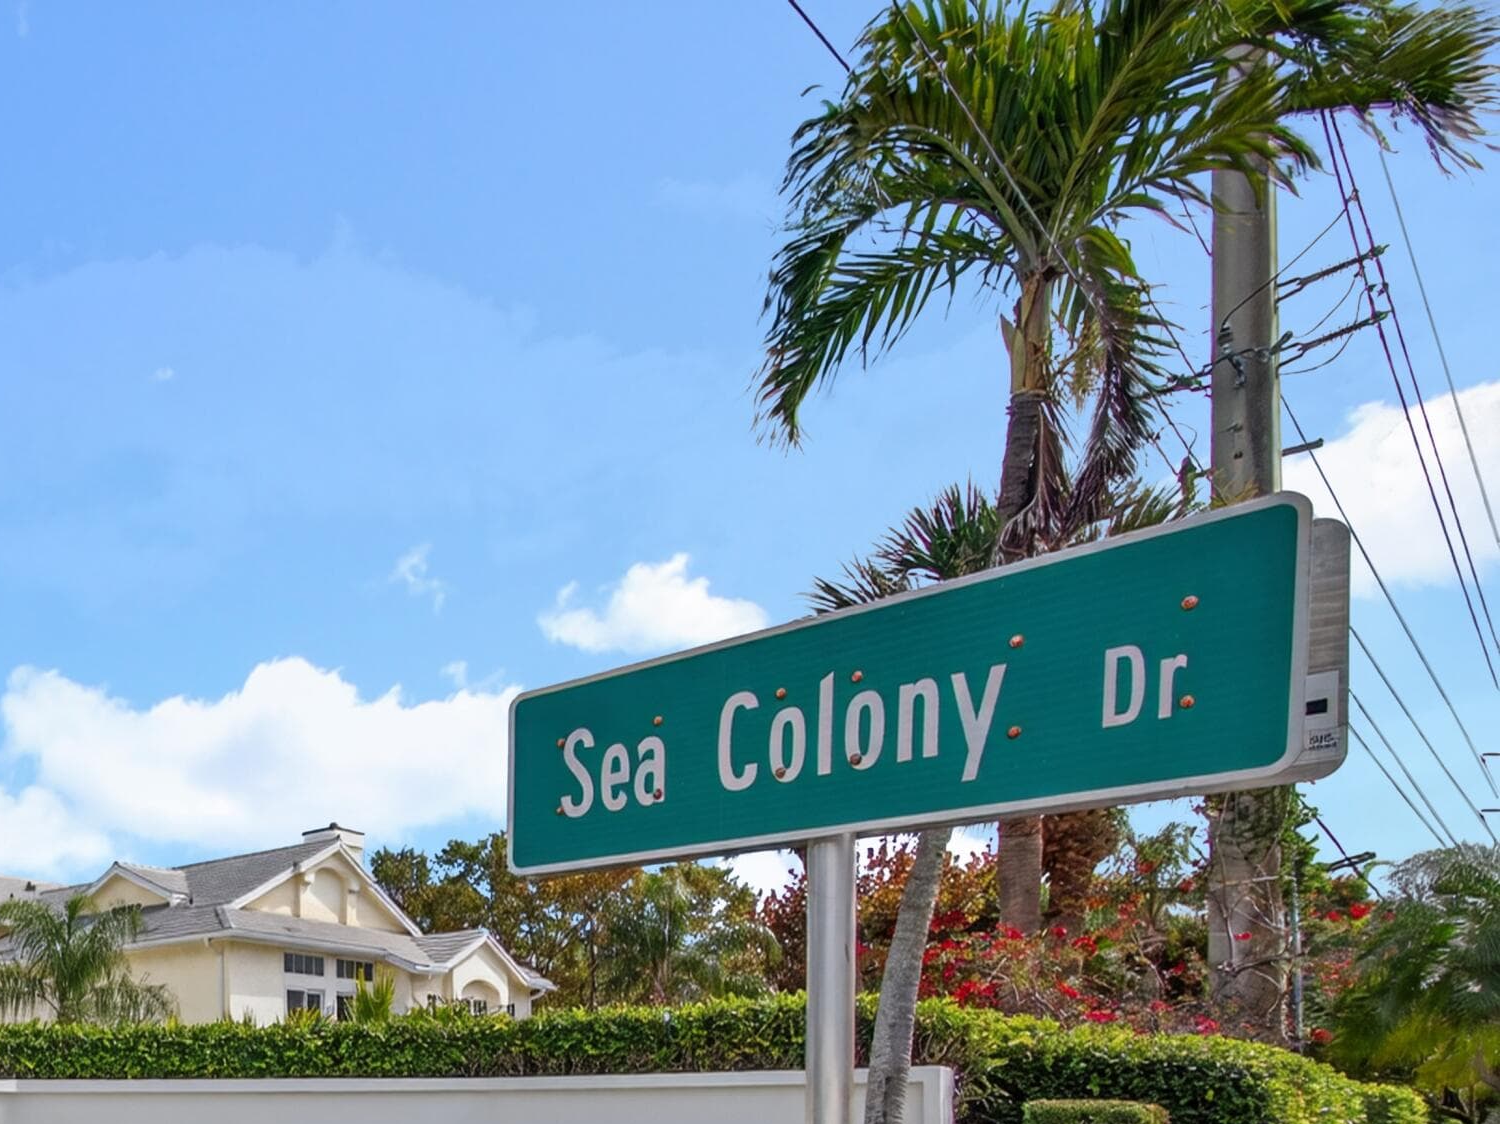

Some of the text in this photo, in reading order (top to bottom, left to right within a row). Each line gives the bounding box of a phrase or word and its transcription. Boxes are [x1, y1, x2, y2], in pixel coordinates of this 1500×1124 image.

[561, 645, 1188, 818] Sea Colony Dr
